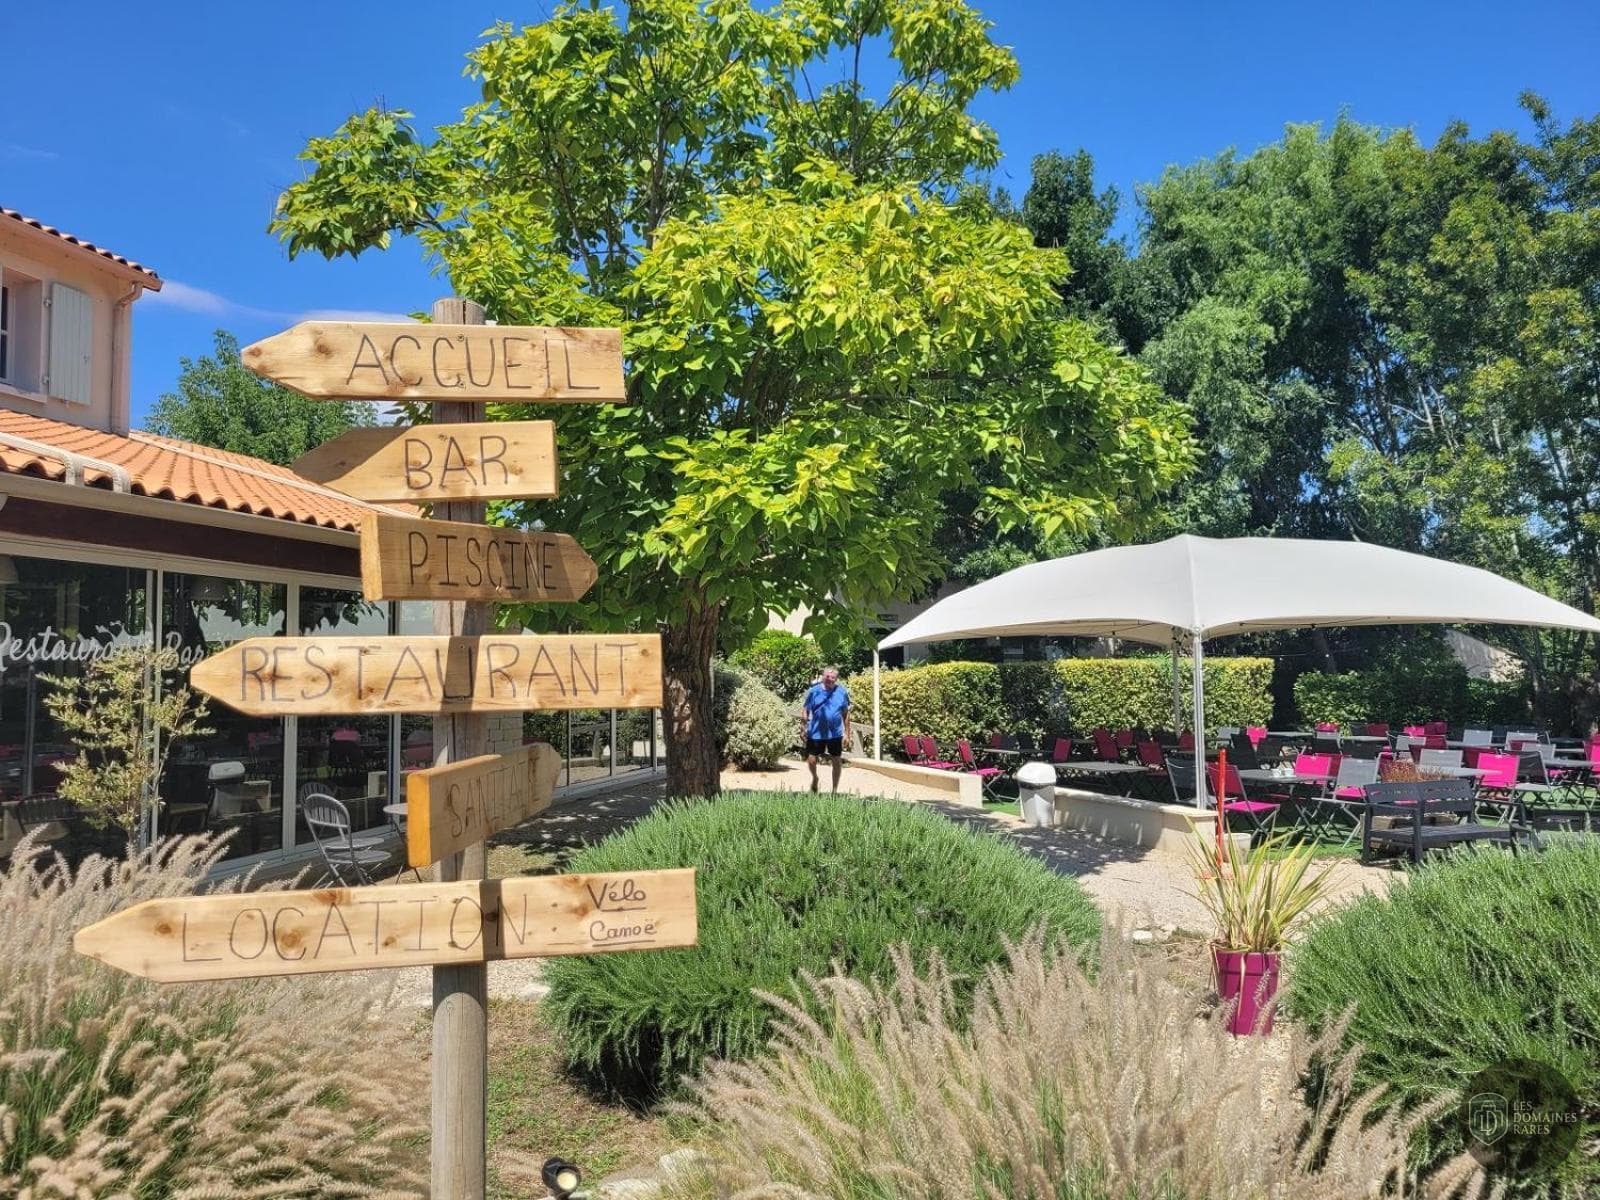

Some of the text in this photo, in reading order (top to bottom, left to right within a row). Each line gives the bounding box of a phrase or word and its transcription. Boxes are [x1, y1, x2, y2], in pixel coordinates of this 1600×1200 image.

[346, 332, 600, 391] ACCUEIL
[404, 435, 509, 490] BAR
[408, 531, 557, 590] PISCINE
[0, 621, 130, 672] Restaura
[241, 643, 638, 702] RESTAURANT
[182, 893, 528, 962] LOCATION
[586, 878, 647, 910] Vélo
[589, 918, 658, 942] Canoë
